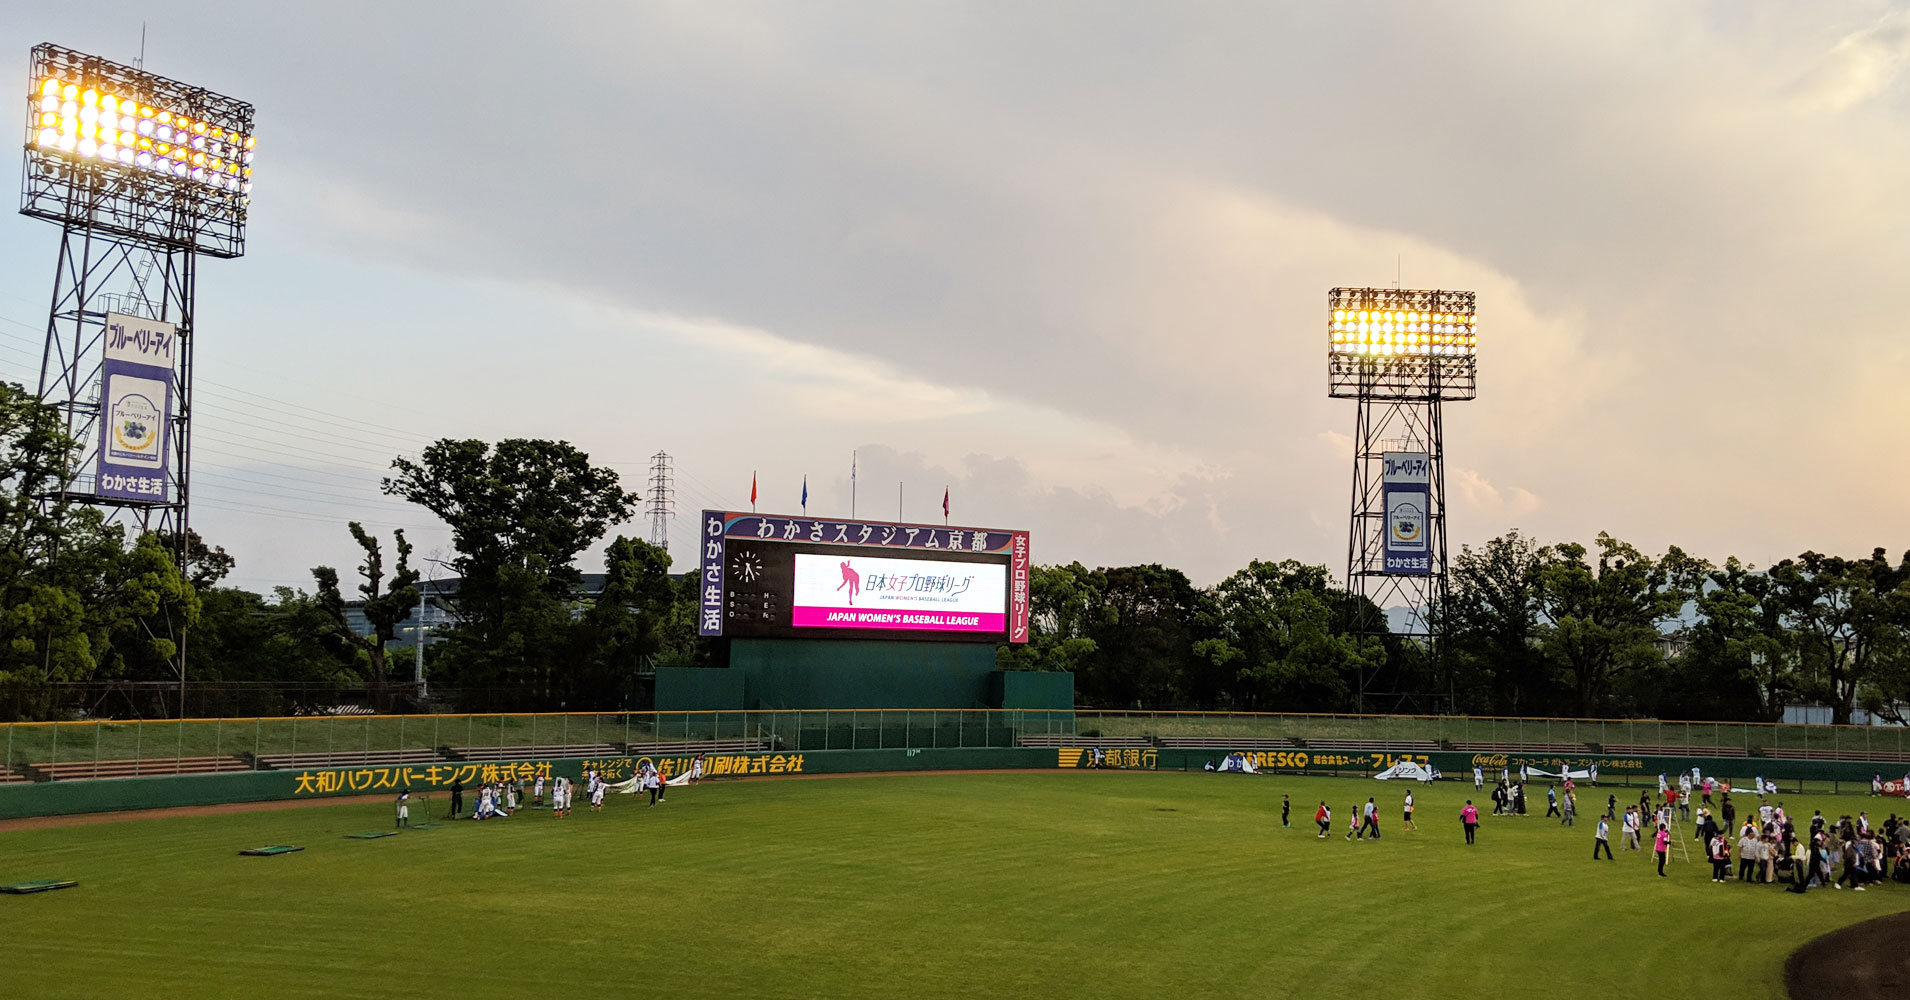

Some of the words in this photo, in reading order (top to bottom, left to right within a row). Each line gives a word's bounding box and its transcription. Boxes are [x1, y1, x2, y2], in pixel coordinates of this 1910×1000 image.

[109, 323, 173, 358] ブルーベリーアイ
[1385, 459, 1428, 477] ブルーベリーアイ
[101, 473, 163, 496] わかさ生活
[757, 517, 988, 552] わかさスタジアム京都
[703, 516, 723, 631] わかさ生活
[1387, 557, 1428, 569] わかさ生活
[865, 573, 975, 597] 日本女子プロ野球リーグ
[1014, 534, 1027, 639] 女子プロ野球リーグ
[826, 611, 857, 622] JAPAN
[858, 612, 901, 623] WOMEN'S
[902, 614, 945, 625] BASEBALL
[946, 616, 979, 626] LEAGUE
[582, 758, 632, 769] チャレンジで
[294, 760, 553, 794] 大和ハウスパーキング株式会社
